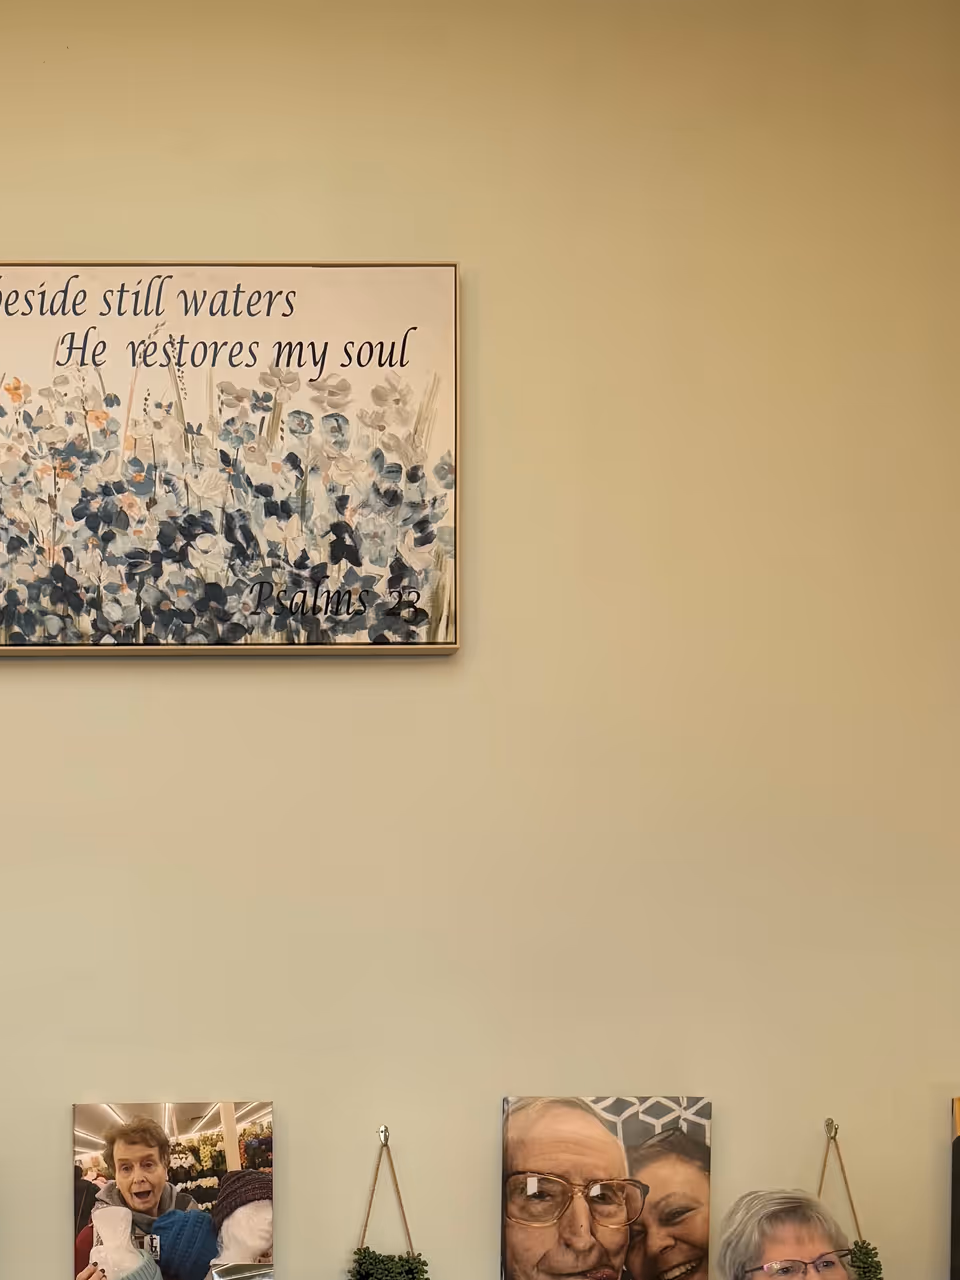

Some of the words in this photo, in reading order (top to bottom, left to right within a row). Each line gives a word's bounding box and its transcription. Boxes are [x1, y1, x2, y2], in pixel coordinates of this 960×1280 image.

[98, 274, 174, 317] still
[176, 282, 297, 317] waters
[56, 325, 107, 367] He
[125, 333, 260, 368] restores
[272, 340, 329, 382] my
[339, 326, 418, 368] soul
[249, 575, 369, 617] Psalms
[386, 590, 422, 622] 23
